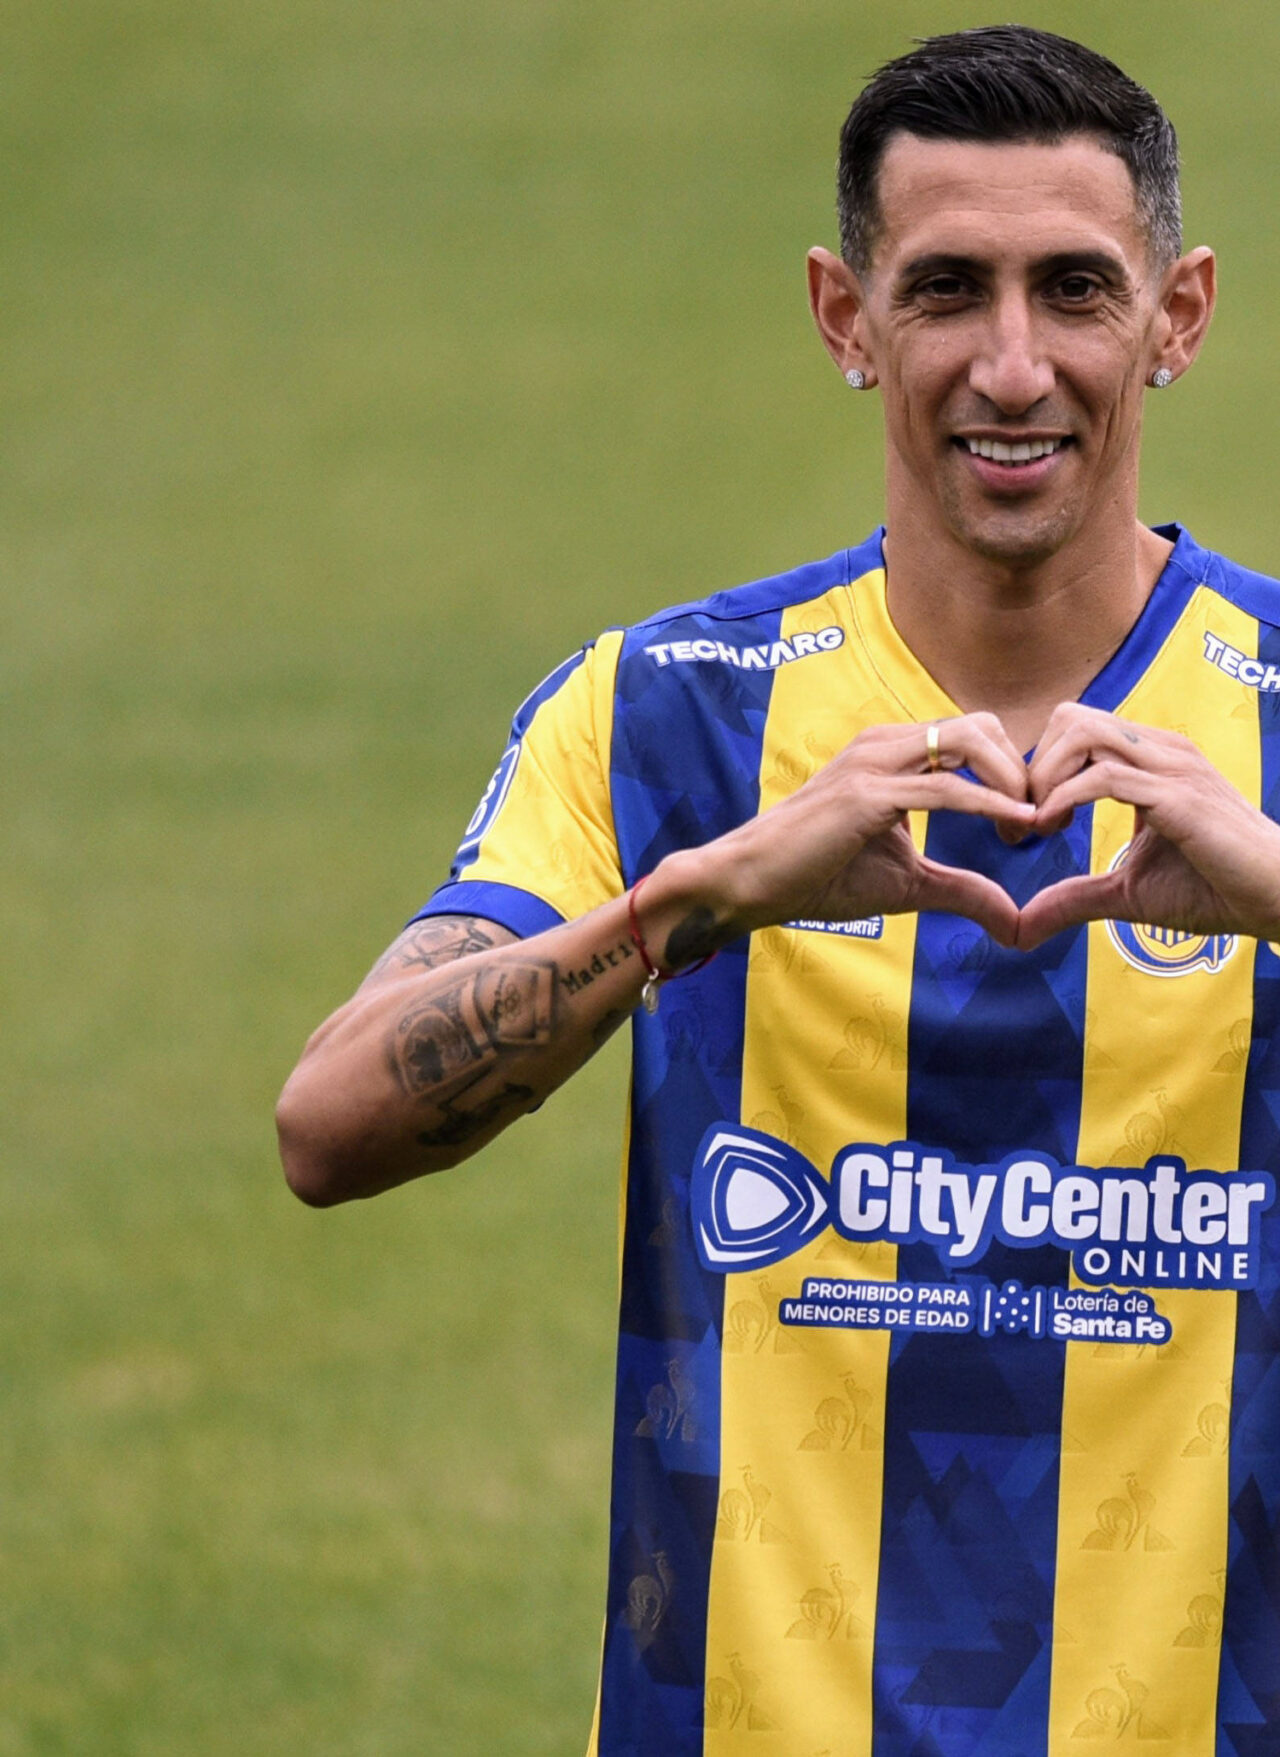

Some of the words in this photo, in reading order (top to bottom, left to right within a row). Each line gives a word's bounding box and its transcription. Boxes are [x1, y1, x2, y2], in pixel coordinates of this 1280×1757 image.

[560, 934, 647, 996] Madri
[839, 1150, 1266, 1257] CityCenter
[1083, 1247, 1249, 1281] ONLINE
[806, 1282, 914, 1303] PROHIBIDO
[917, 1288, 971, 1306] PARA
[1053, 1291, 1120, 1313] Lotería
[1123, 1296, 1149, 1314] de
[784, 1303, 881, 1324] MENORES
[884, 1309, 911, 1326] DE
[914, 1310, 970, 1329] EDAD
[1053, 1312, 1133, 1338] Santa
[1135, 1315, 1167, 1340] Fe
